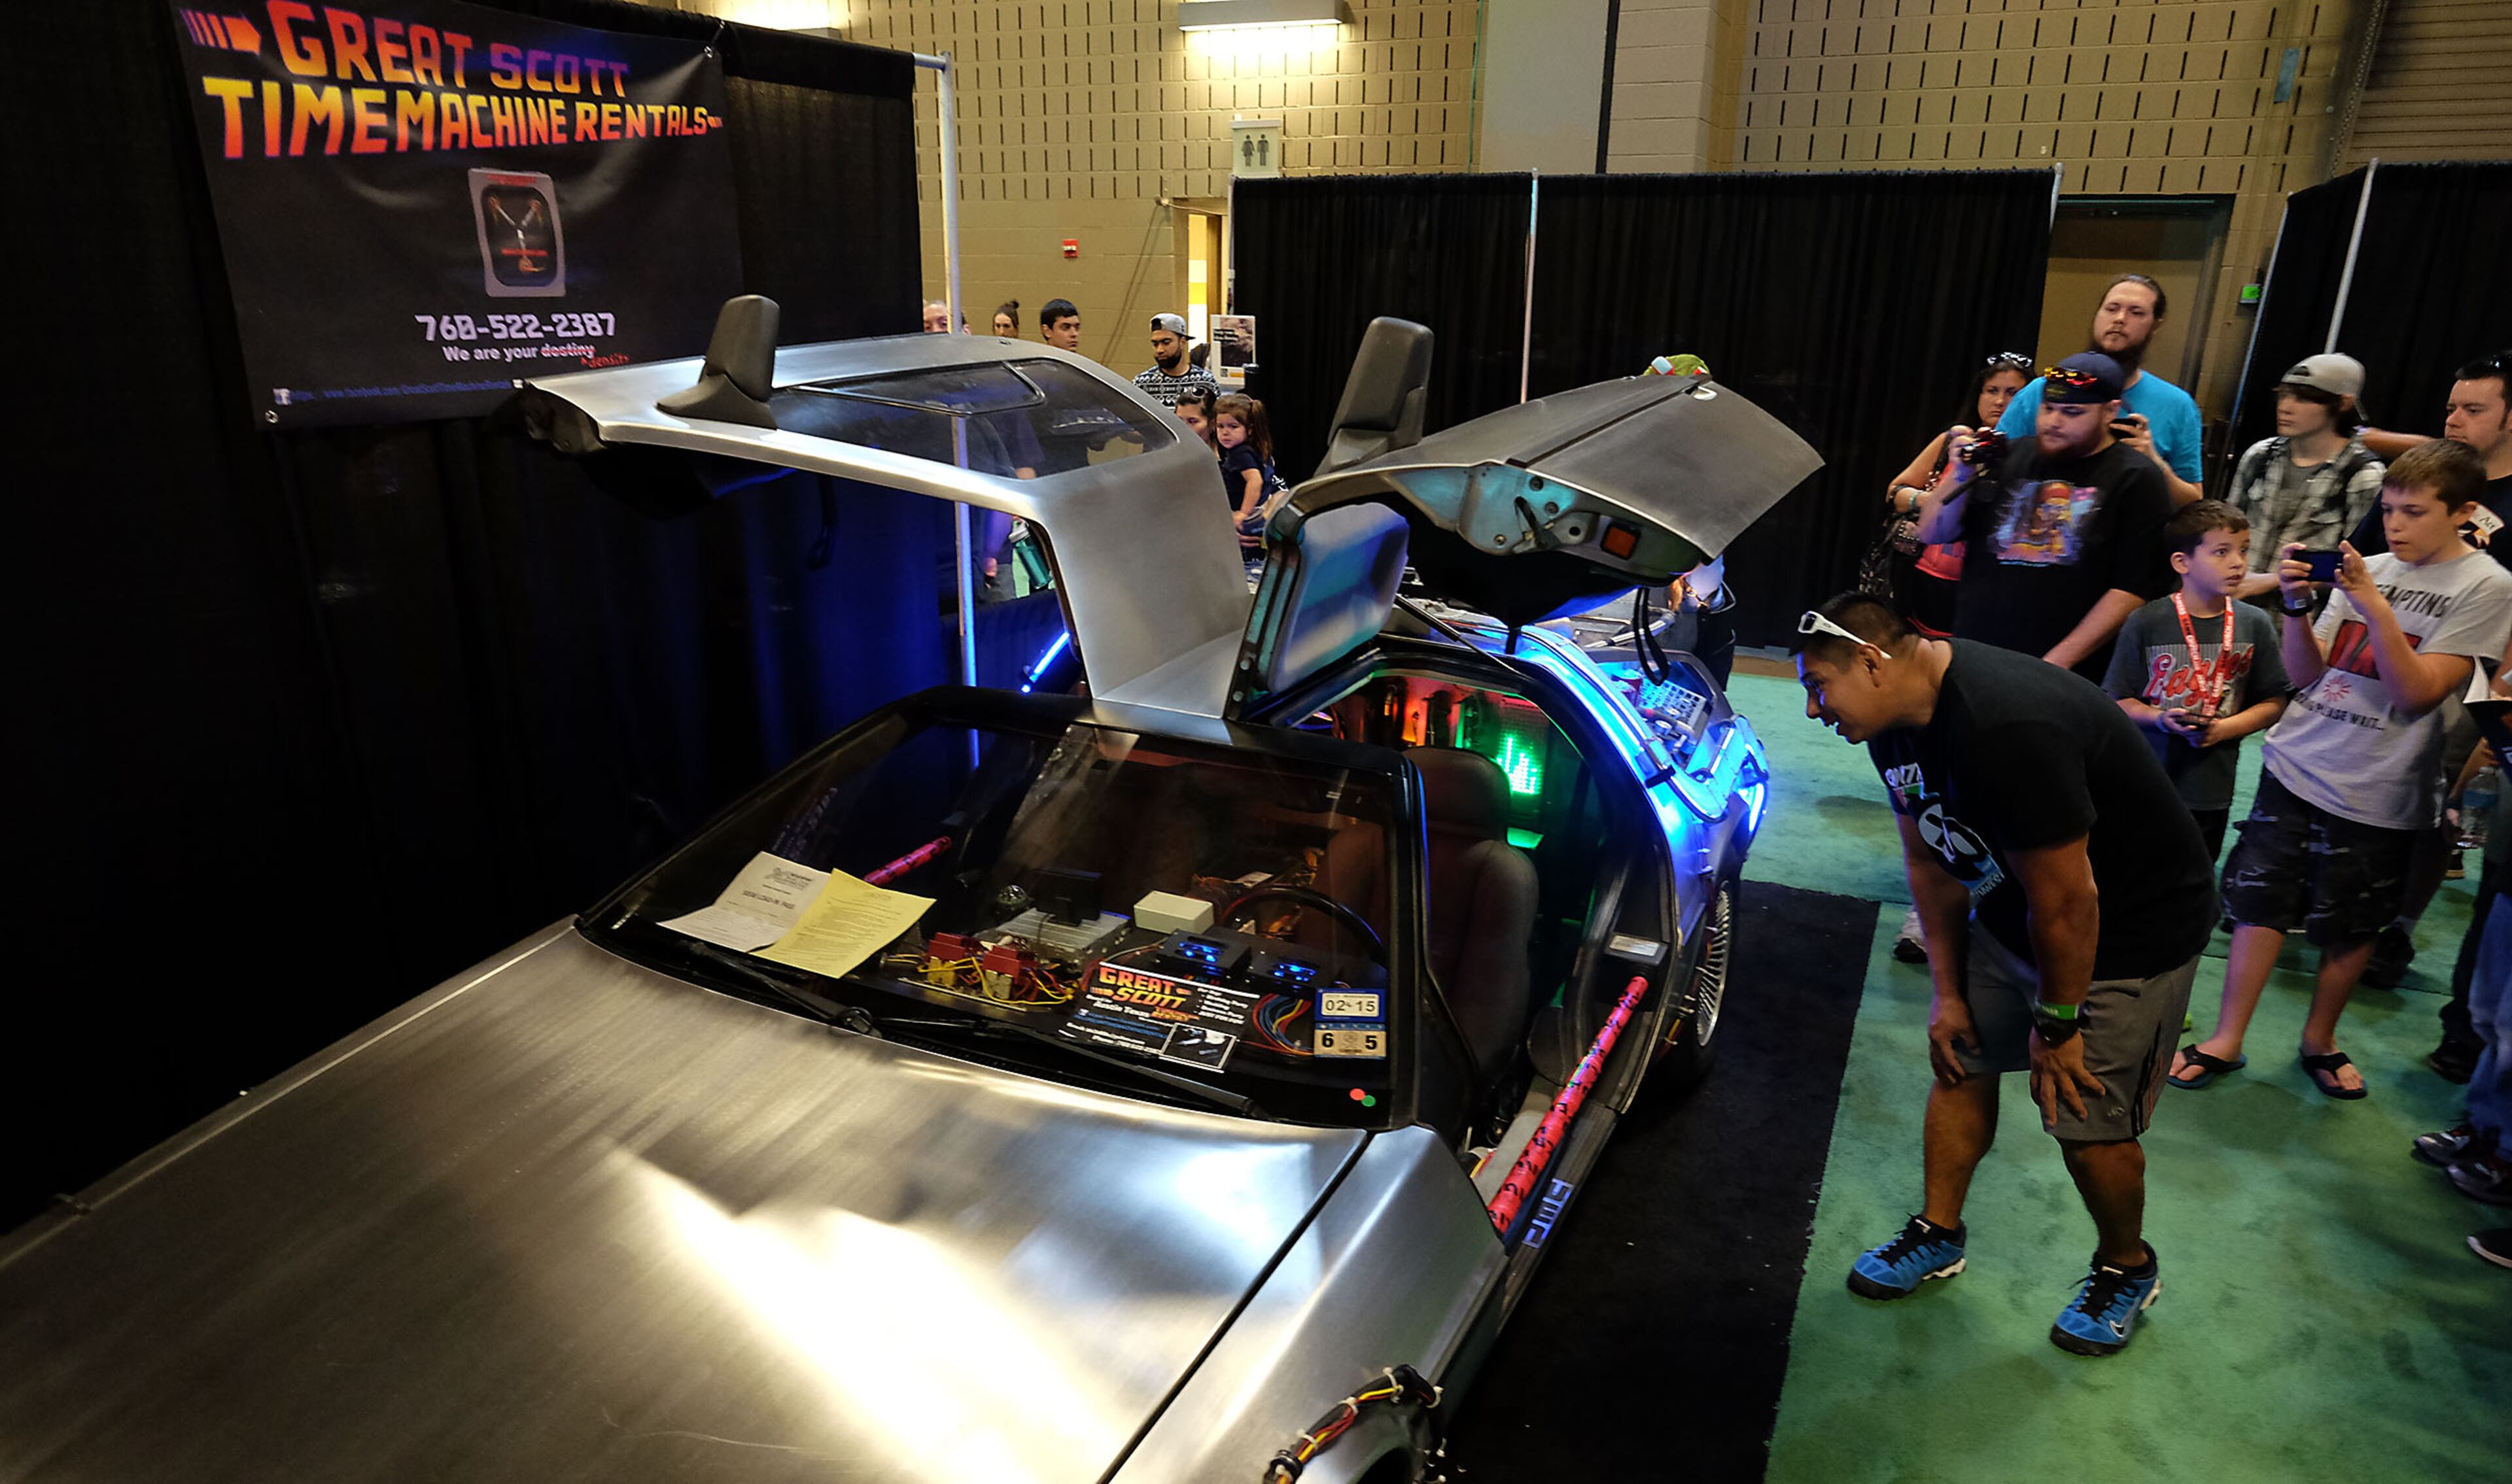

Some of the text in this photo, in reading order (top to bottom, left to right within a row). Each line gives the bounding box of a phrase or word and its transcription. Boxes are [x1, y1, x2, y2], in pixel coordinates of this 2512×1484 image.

[268, 0, 628, 96] GREAT SCOTT
[574, 101, 708, 142] RENTALS
[415, 312, 616, 341] 760-522-2387
[442, 343, 596, 362] We are your destiny
[1099, 967, 1176, 995] GREAT
[1112, 988, 1187, 1009] SCOTT
[1321, 1032, 1378, 1050] 6 5
